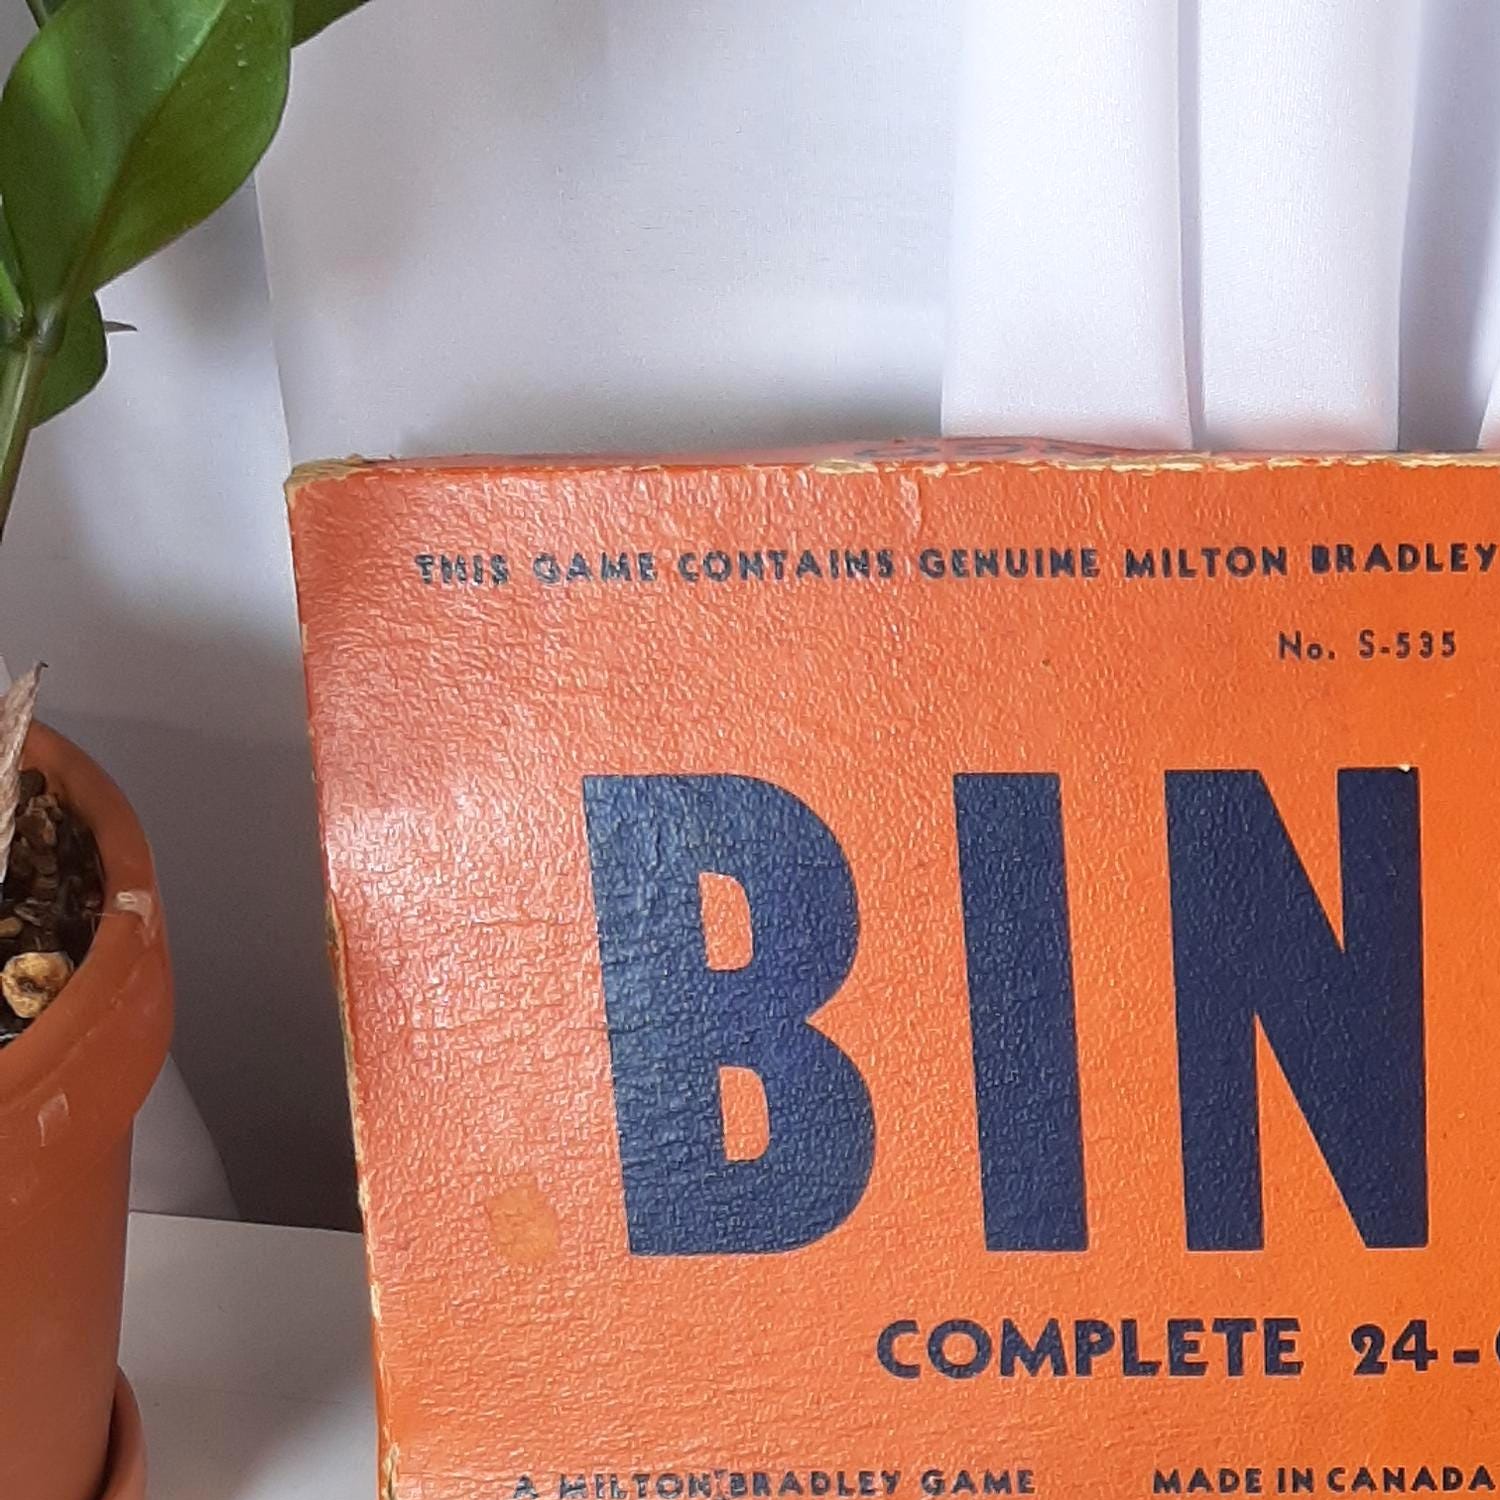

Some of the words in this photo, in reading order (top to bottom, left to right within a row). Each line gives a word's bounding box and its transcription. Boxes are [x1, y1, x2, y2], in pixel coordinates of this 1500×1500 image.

[415, 555, 509, 585] THIS
[533, 552, 653, 583] GAME
[678, 549, 894, 582] CONTAINS
[919, 548, 1099, 578] GENUINE
[1126, 547, 1286, 578] MILTON
[1312, 543, 1496, 574] BRADLEY
[1279, 631, 1334, 659] No.
[1360, 630, 1455, 658] S-535
[877, 1318, 1303, 1379] COMPLETE
[513, 1474, 539, 1499] A
[560, 1472, 711, 1499] MILTON
[730, 1471, 900, 1498] BRADLEY
[921, 1470, 1034, 1496] GAME
[1153, 1468, 1261, 1493] MADE
[1278, 1468, 1313, 1493] IN
[1327, 1466, 1495, 1492] CANADA
